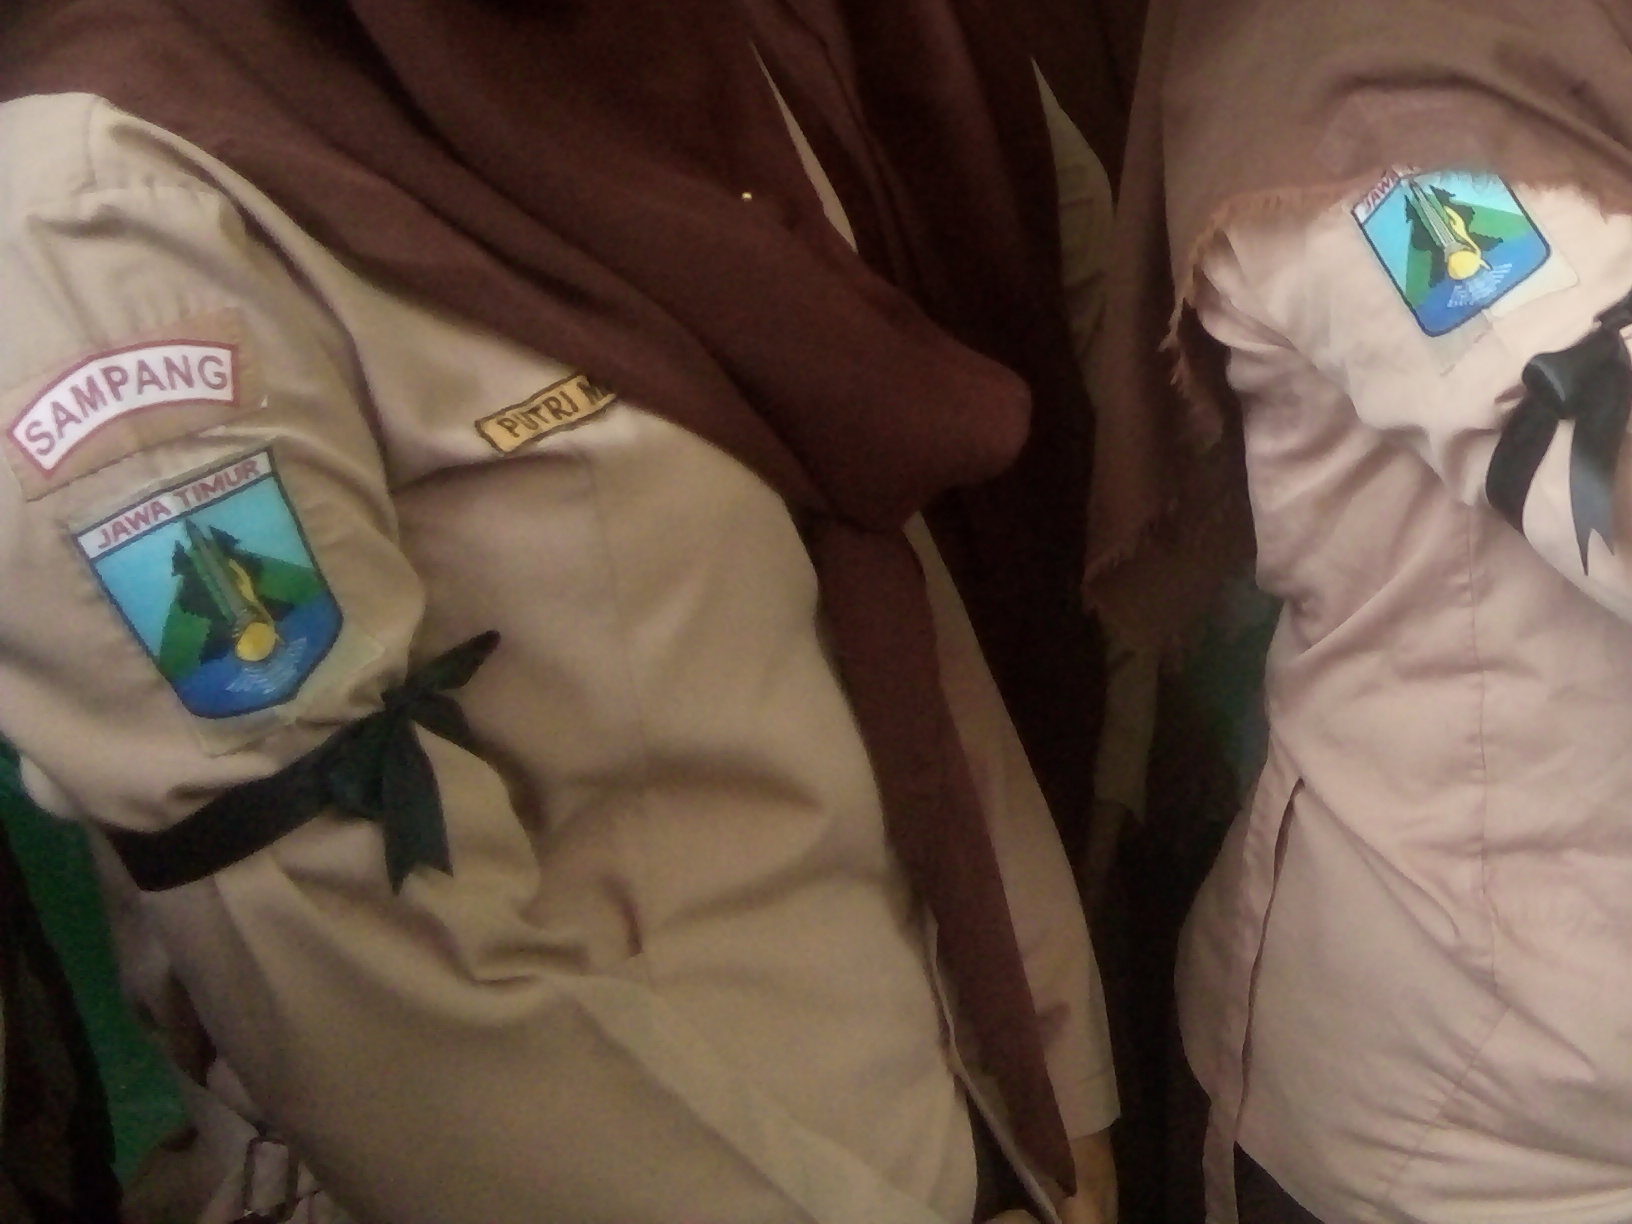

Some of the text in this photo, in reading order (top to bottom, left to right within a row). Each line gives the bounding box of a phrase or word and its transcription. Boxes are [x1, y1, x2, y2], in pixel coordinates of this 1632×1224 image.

[25, 353, 229, 456] SAMPANG
[497, 390, 579, 438] PUTRI
[97, 459, 261, 550] JAWA TIMUR
